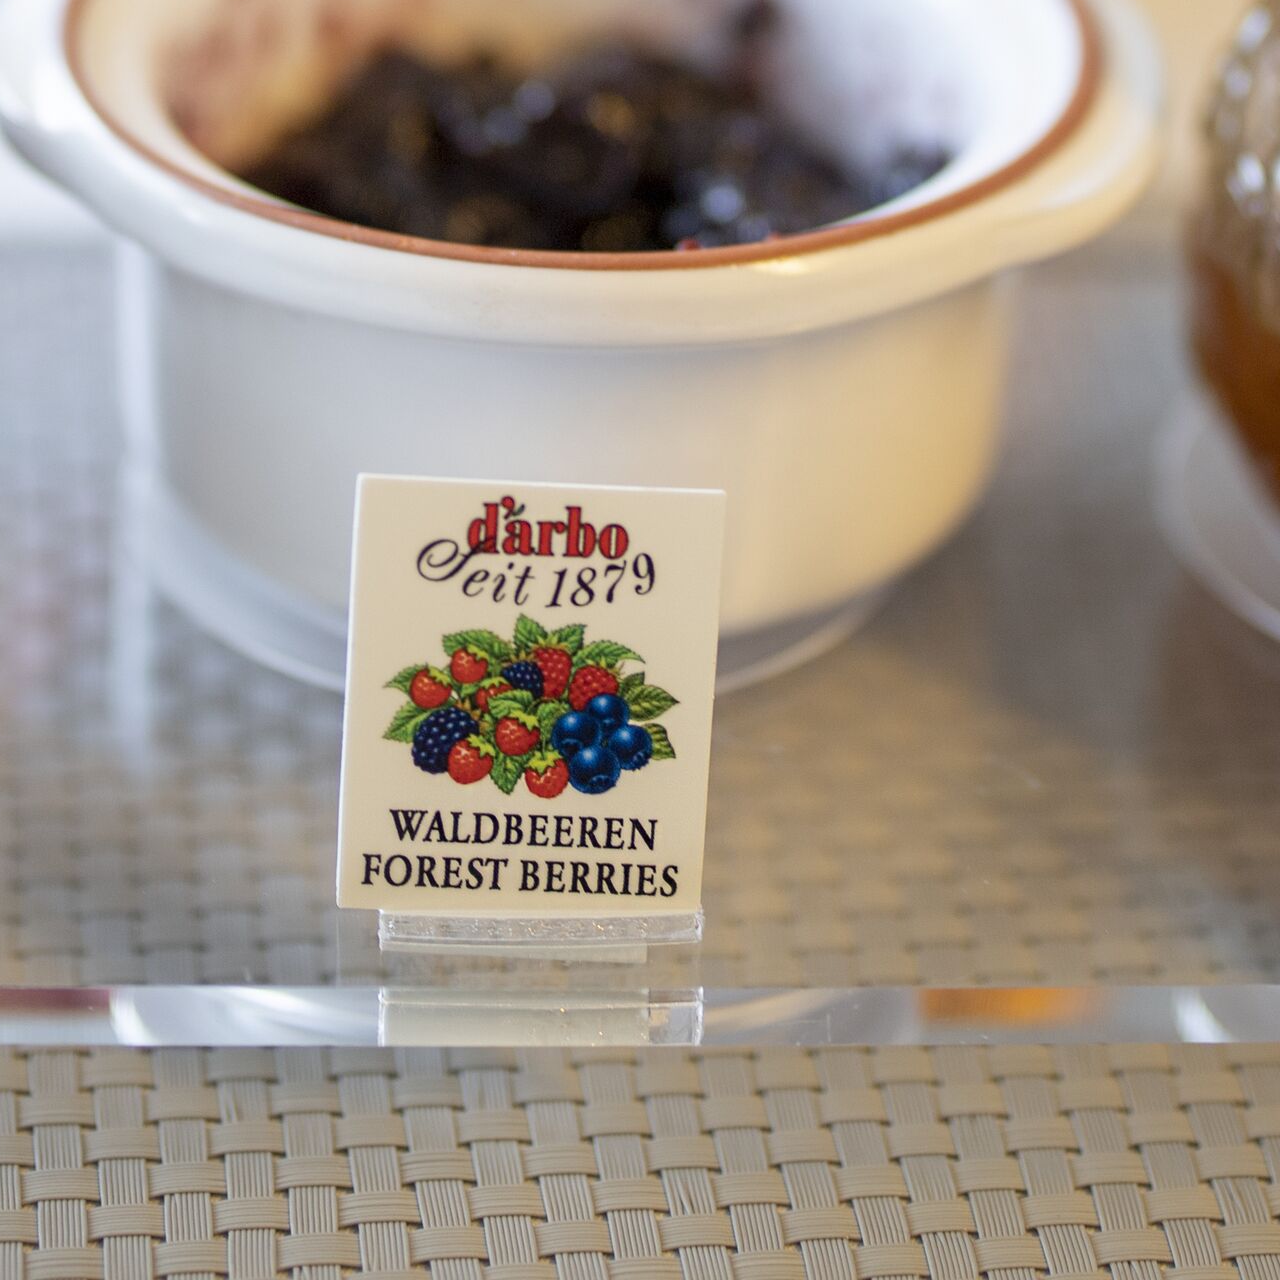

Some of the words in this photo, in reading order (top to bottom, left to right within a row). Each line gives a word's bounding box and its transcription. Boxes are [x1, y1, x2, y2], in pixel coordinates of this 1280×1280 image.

[416, 538, 536, 606] Seit
[545, 552, 656, 608] 1879
[389, 808, 658, 851] WALDBEEREN
[361, 853, 508, 891] FOREST
[518, 859, 680, 898] BERRIES
